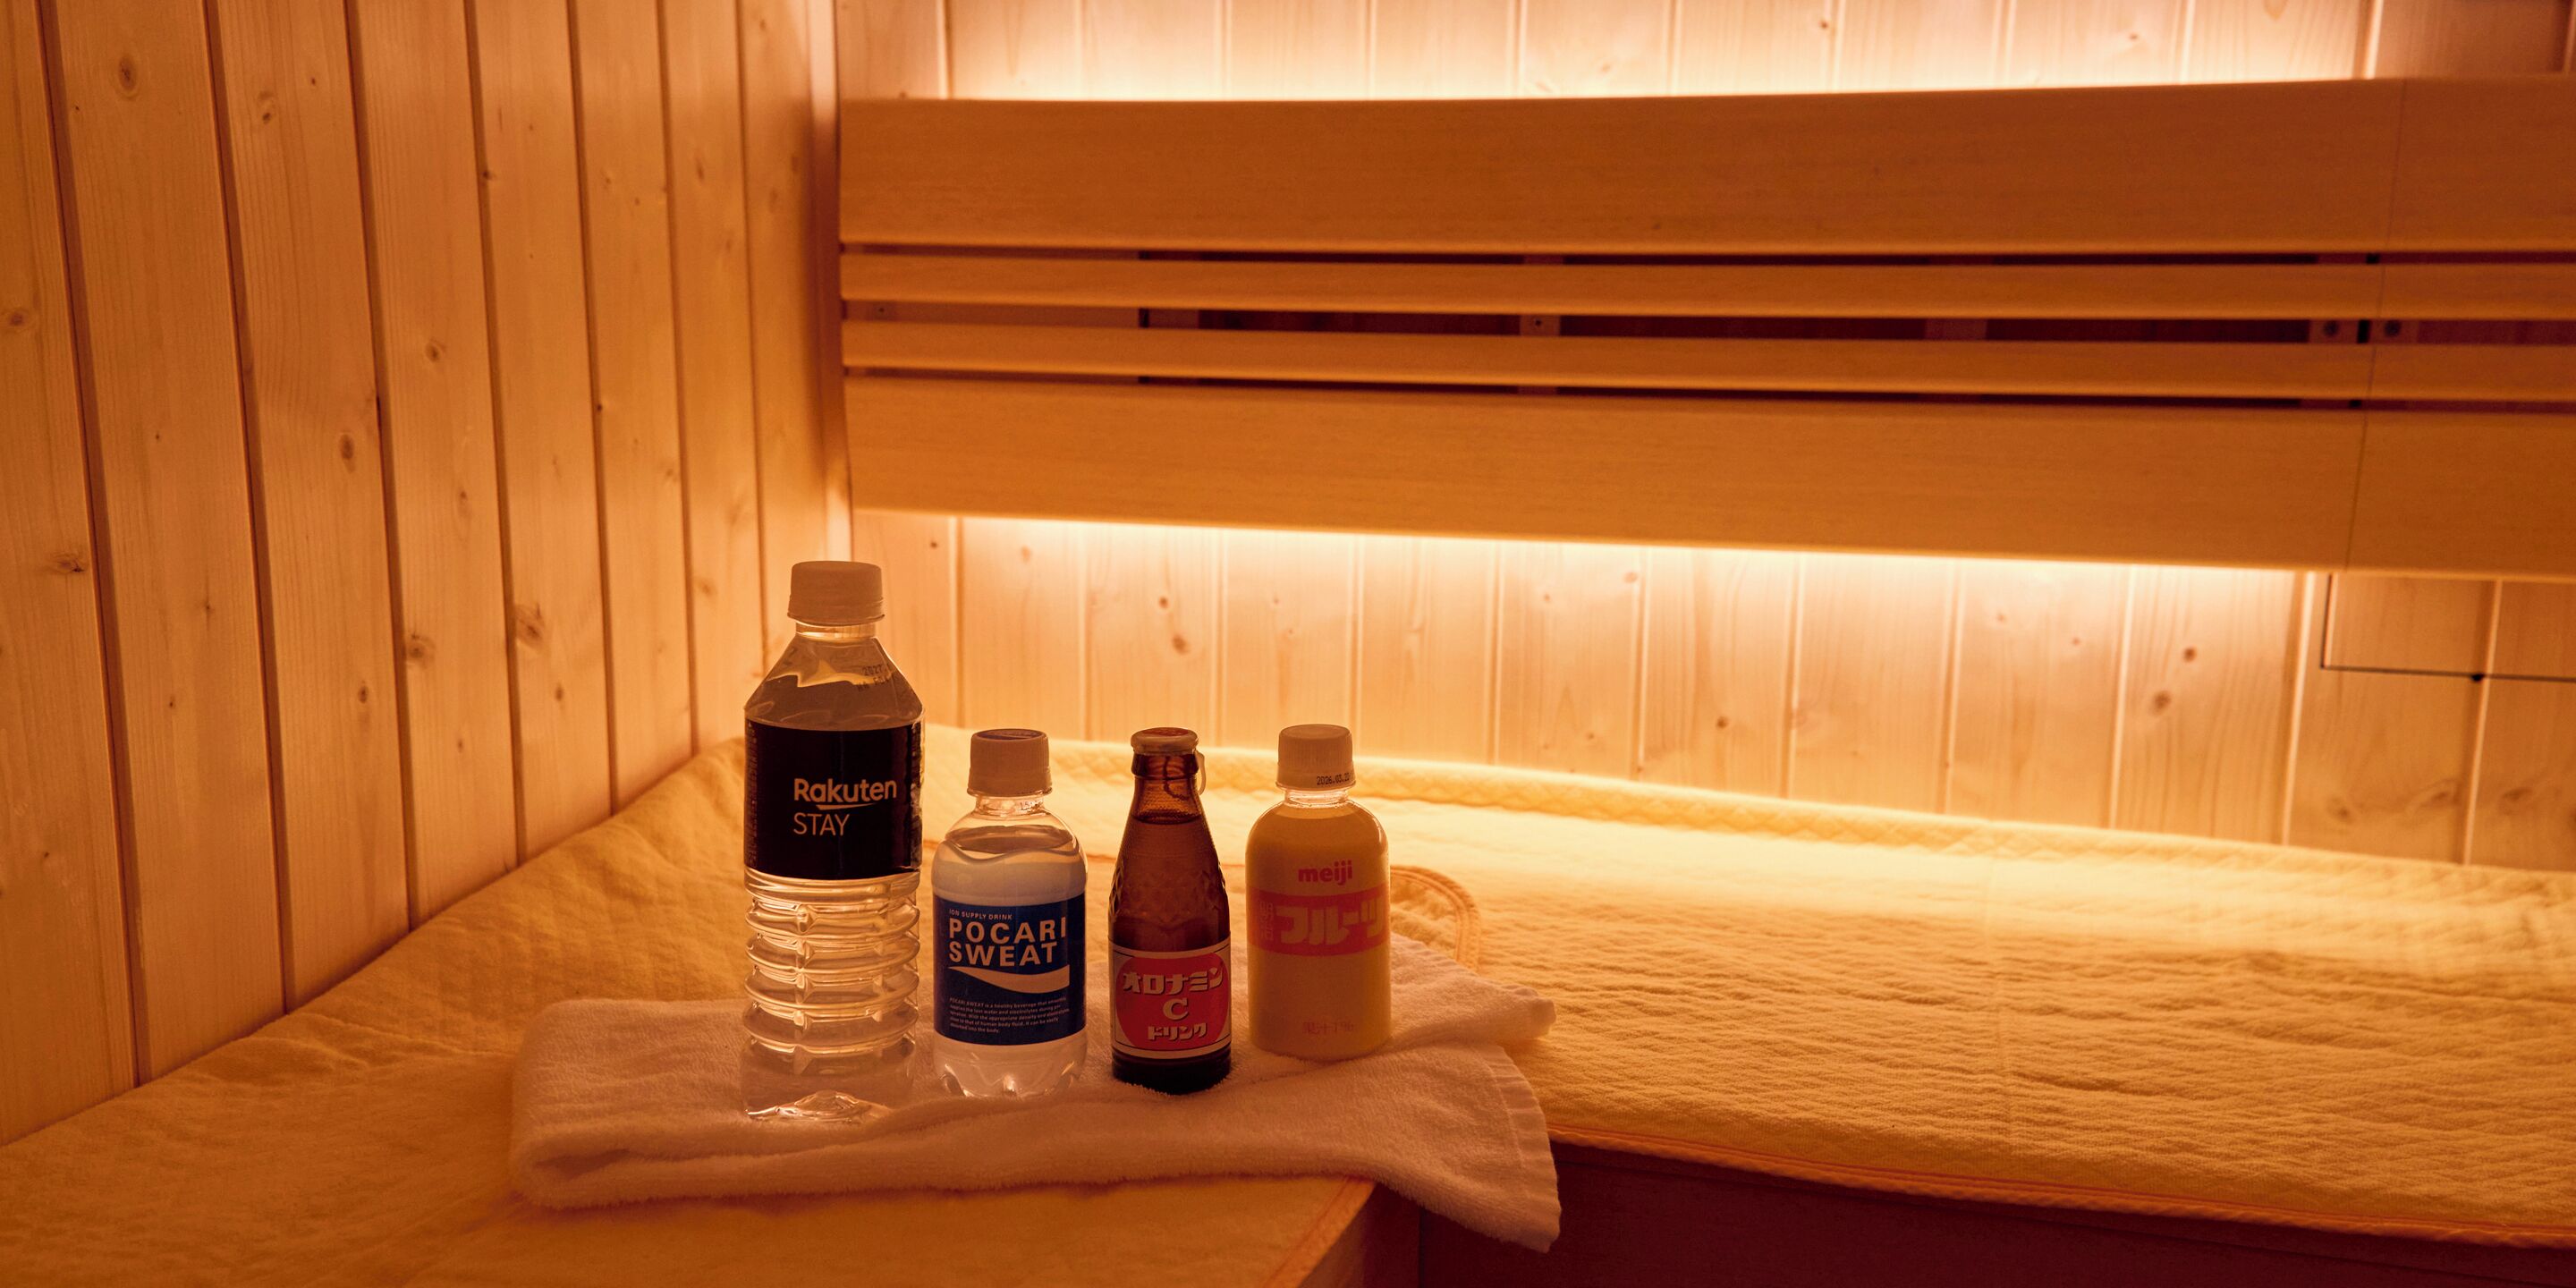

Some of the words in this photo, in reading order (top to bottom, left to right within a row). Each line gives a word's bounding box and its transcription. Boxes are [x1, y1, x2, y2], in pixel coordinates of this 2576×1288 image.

[793, 778, 897, 803] Rakuten
[793, 812, 850, 836] STAY
[1298, 860, 1353, 886] meiji
[949, 908, 960, 917] ION
[961, 911, 986, 920] SUPPLY
[987, 913, 1013, 921] DRINK
[1275, 896, 1384, 945] フルーツ
[949, 916, 1067, 945] POCARI
[948, 940, 1058, 967] SWEAT
[1123, 966, 1224, 996] オロナミン
[1163, 996, 1189, 1021] C
[1148, 1022, 1208, 1042] ドリンク
